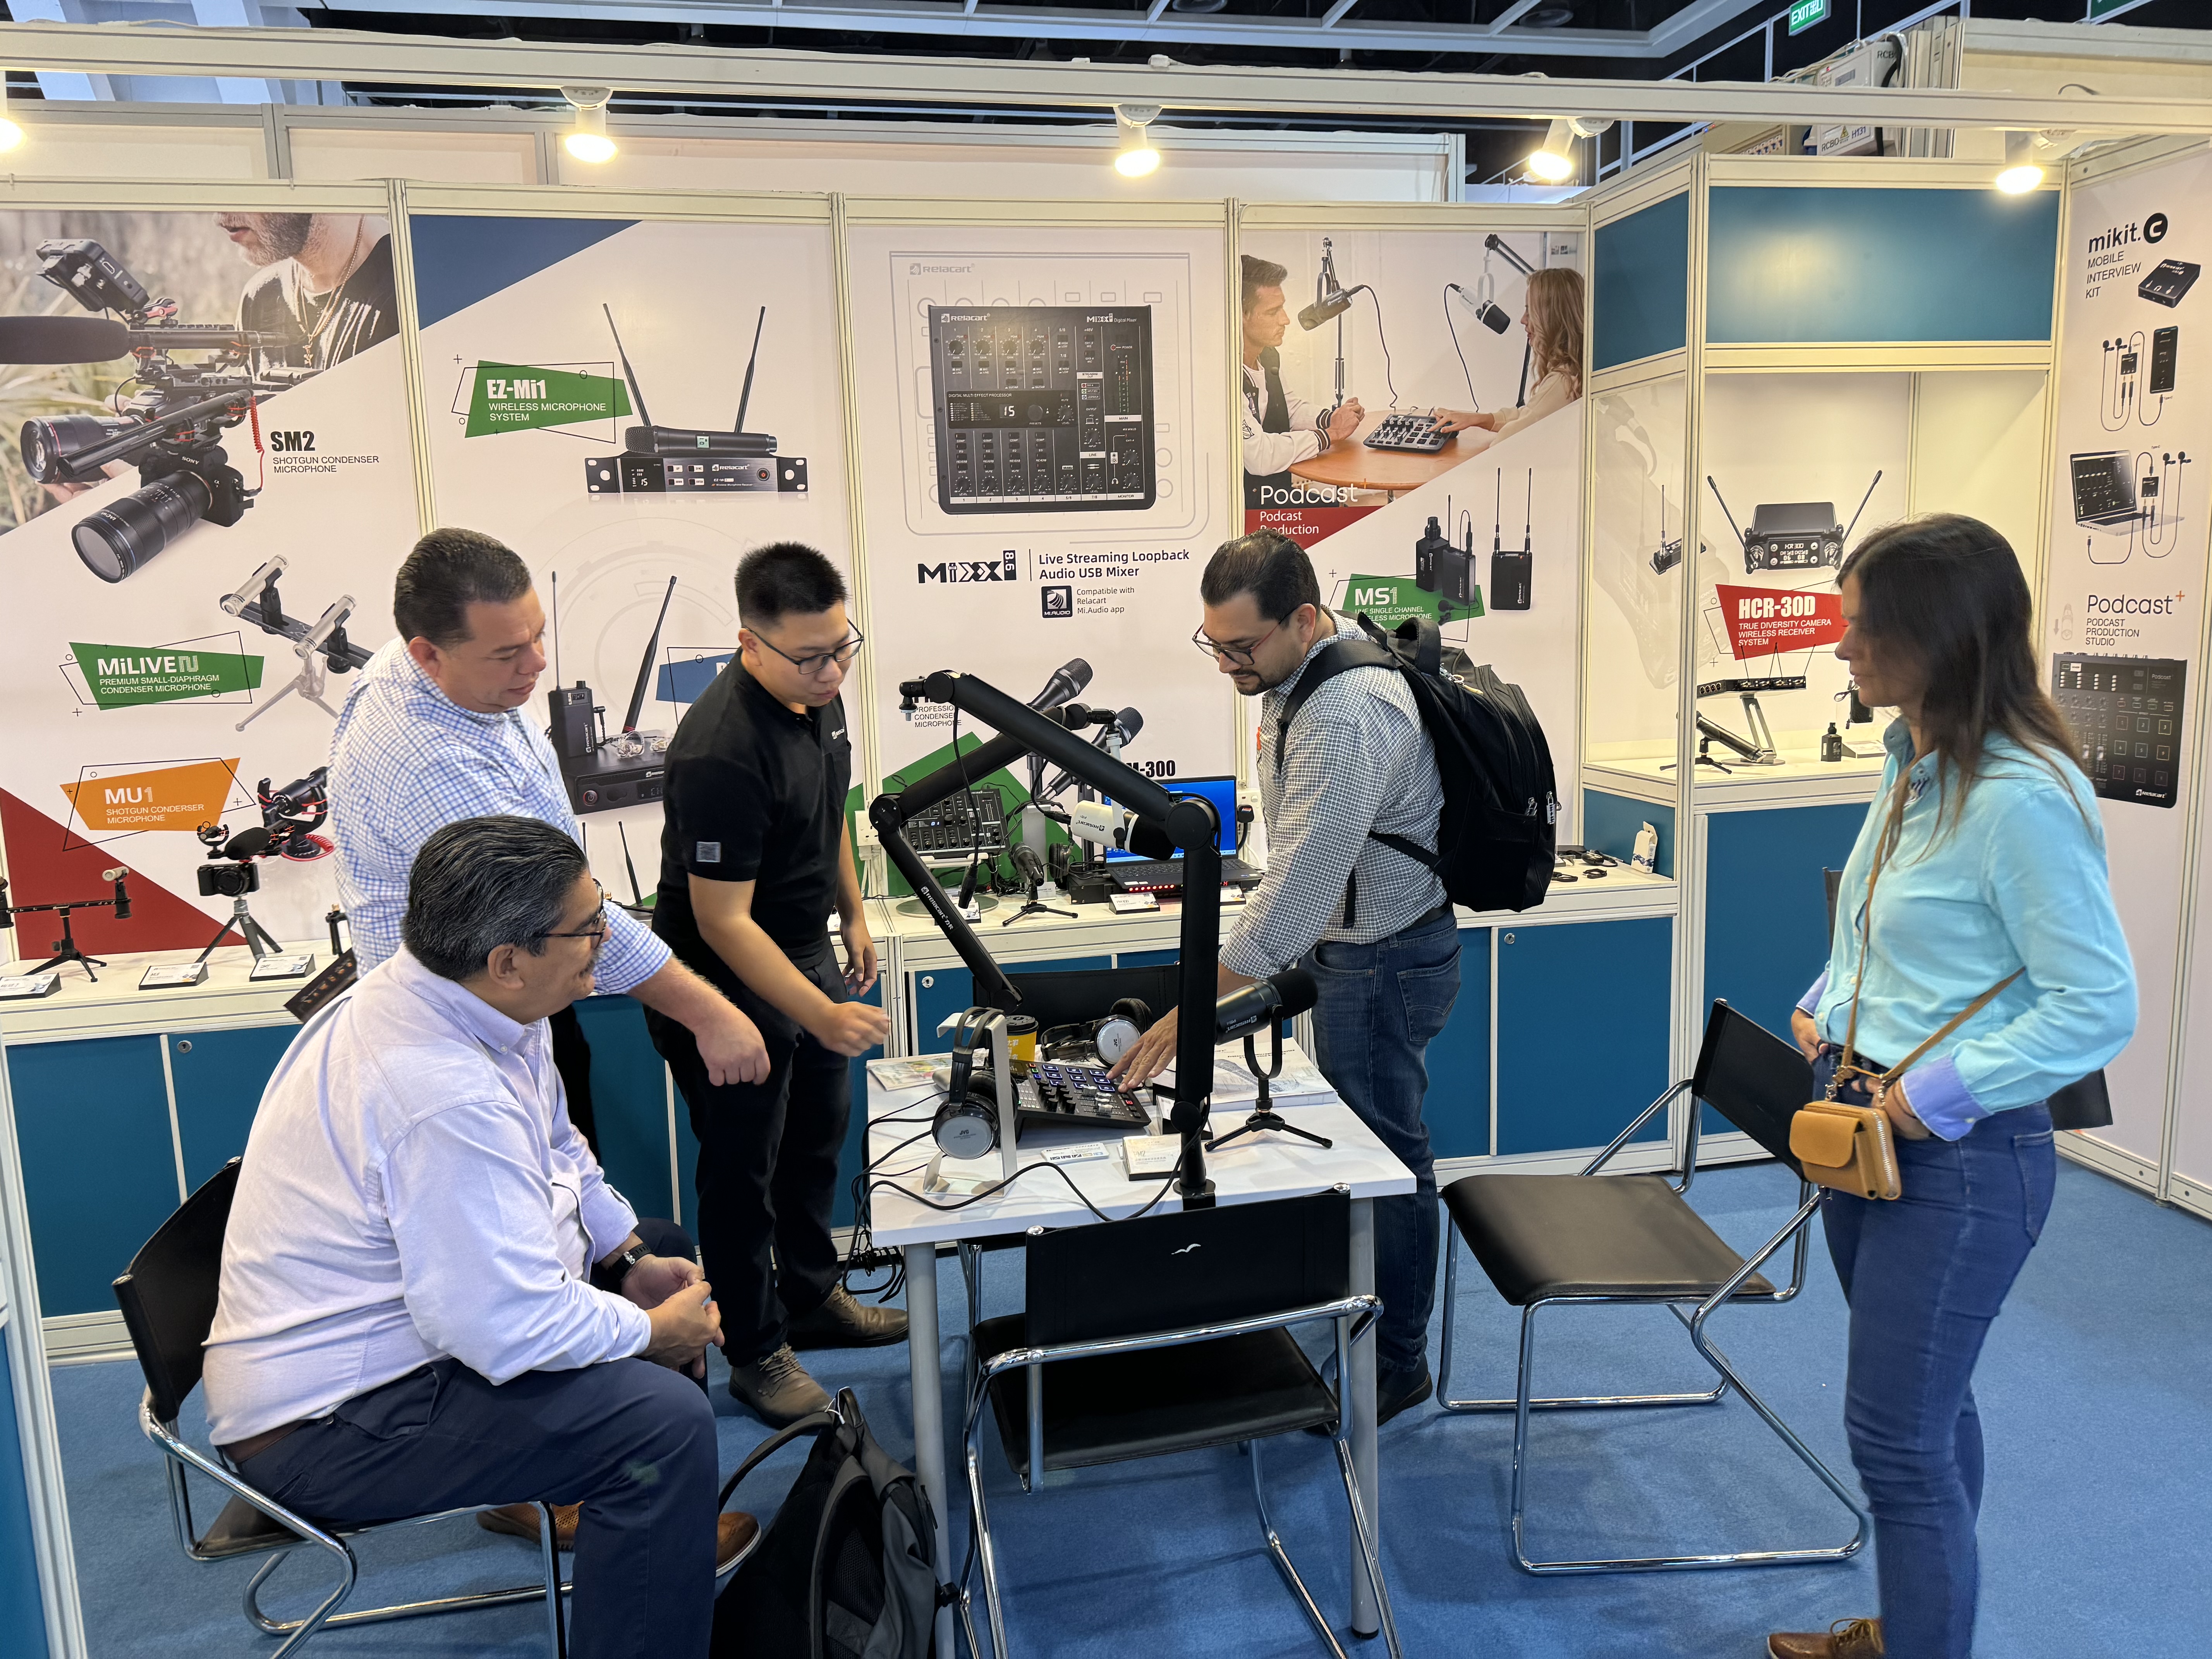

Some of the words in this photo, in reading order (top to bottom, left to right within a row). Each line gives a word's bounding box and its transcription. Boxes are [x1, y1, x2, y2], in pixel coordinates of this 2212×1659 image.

[1791, 3, 1811, 26] EXIT
[1822, 137, 1839, 151] RCBO
[2088, 251, 2124, 269] MOBILE
[2087, 262, 2142, 284] INTERVIEW
[2086, 286, 2101, 299] KIT
[487, 380, 546, 399] EZ-Mi1
[489, 403, 539, 411] WIRELESS
[541, 403, 606, 411] MICROPHONE
[489, 412, 529, 421] SYSTEM
[271, 431, 315, 451] SM2
[182, 457, 199, 465] SONY
[1260, 510, 1302, 522] Podcast
[1039, 554, 1064, 565] Live
[1066, 551, 1130, 565] Streaming
[1132, 549, 1190, 563] Loopback
[1039, 568, 1075, 580] Audio
[1079, 567, 1103, 578] USB
[1106, 566, 1139, 577] Mixer
[1077, 587, 1117, 596] Compatible
[1355, 587, 1397, 606] MS1
[1739, 596, 1815, 619] HCR-30D
[1760, 620, 1799, 629] DIVERSITY
[1800, 619, 1831, 627] CAMERA
[2087, 618, 2126, 627] PODCAST
[1738, 629, 1776, 638] WIRELESS
[1778, 628, 1815, 636] RECEIVER
[2087, 628, 2140, 637] PRODUCTION
[1739, 638, 1769, 646] SYSTEM
[2086, 637, 2115, 646] STUDIO
[98, 657, 176, 676] MiLIVE
[141, 675, 219, 684] SMALL-DIAPHRAGM
[101, 685, 153, 694] CONDENSER
[155, 683, 211, 692] MICROPHONE
[105, 787, 153, 804] MU1
[106, 807, 148, 815] SHOTGUN
[151, 804, 204, 813] CONDERSER
[107, 814, 165, 824] MICROPHONE
